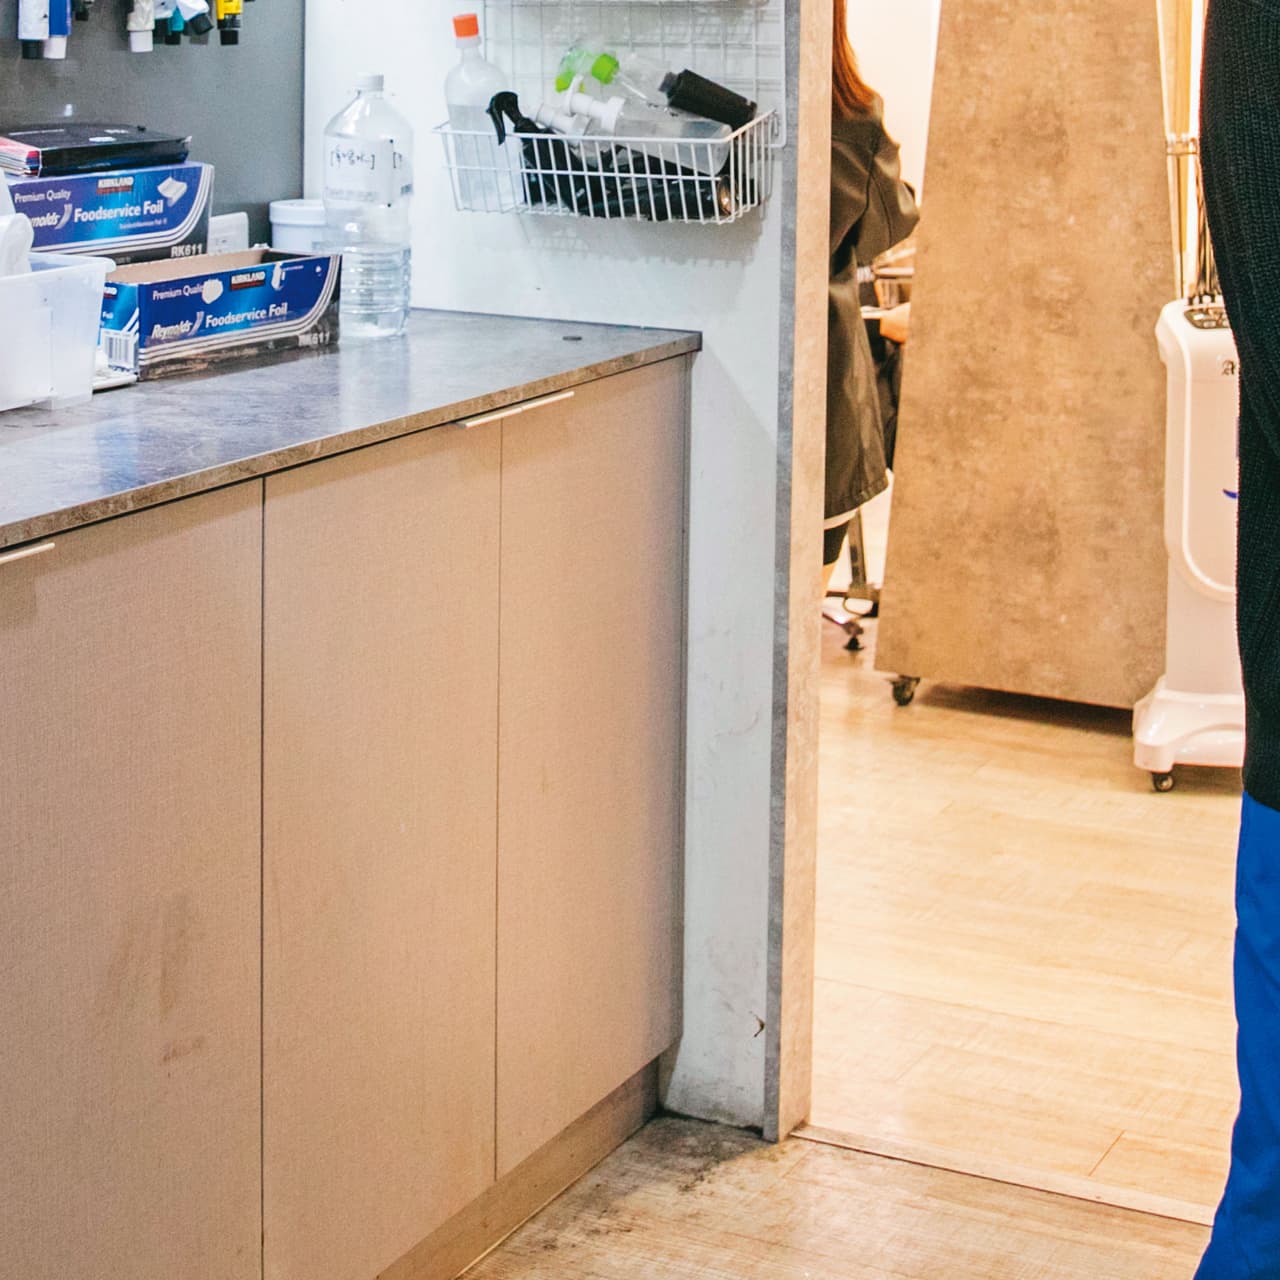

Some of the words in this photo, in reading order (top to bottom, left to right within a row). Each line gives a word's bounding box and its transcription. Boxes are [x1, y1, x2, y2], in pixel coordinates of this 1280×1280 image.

[98, 177, 134, 188] KIRKLAND
[14, 191, 46, 203] Premium
[46, 189, 72, 201] Quality
[74, 204, 141, 222] Foodservice
[143, 200, 164, 215] Foil
[171, 243, 203, 257] RK611
[231, 271, 266, 284] KIRKLAND
[152, 289, 183, 301] Premium
[205, 308, 267, 329] Foodservice
[269, 303, 288, 317] Foil
[151, 320, 192, 340] Reynolds
